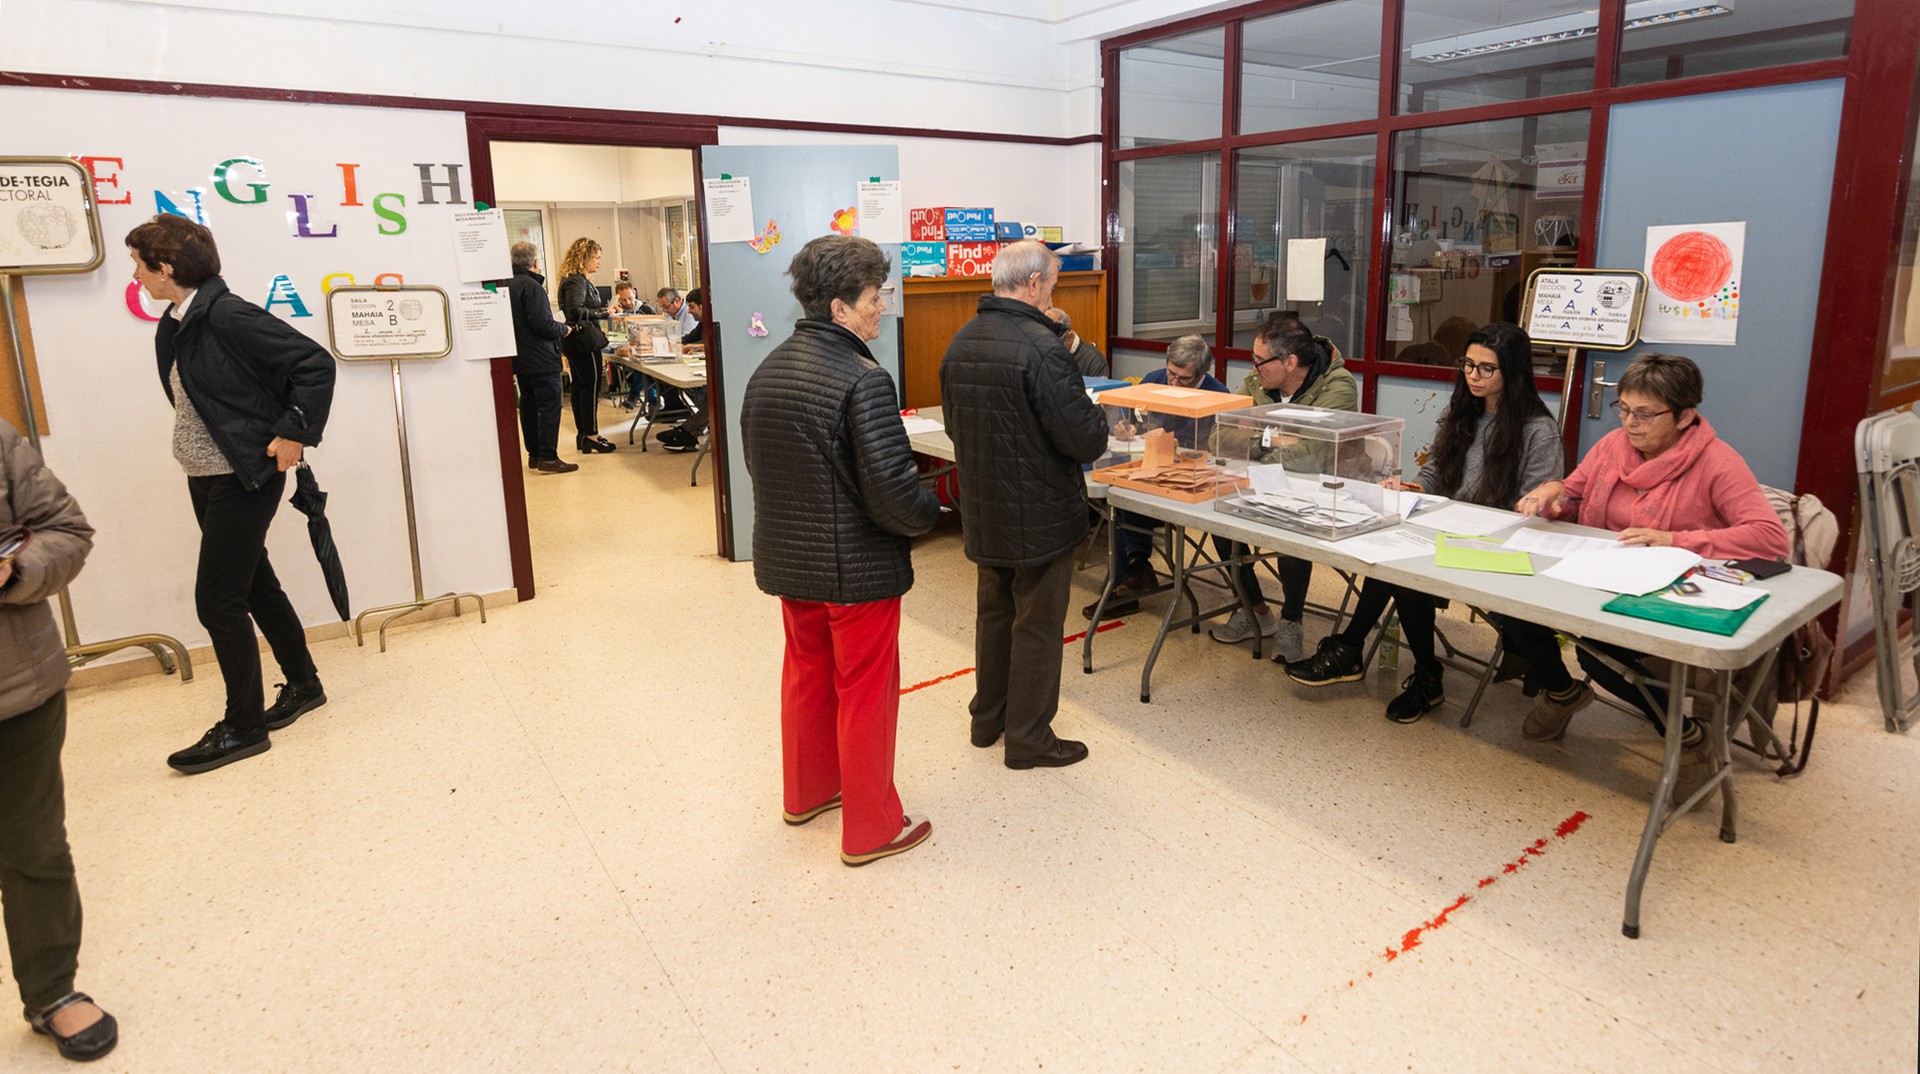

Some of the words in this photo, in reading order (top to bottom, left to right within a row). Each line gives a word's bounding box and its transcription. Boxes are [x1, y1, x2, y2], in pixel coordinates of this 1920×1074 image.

[68, 155, 468, 239] ENGLISH
[912, 208, 934, 225] Out!
[966, 212, 982, 220] Find
[921, 225, 944, 240] Find
[916, 246, 933, 254] Find
[948, 243, 982, 260] Find
[1574, 279, 1584, 293] 2
[387, 300, 394, 310] 2
[1541, 304, 1552, 313] A
[1590, 306, 1598, 316] K
[1565, 299, 1575, 310] A
[389, 314, 397, 326] B
[1561, 321, 1571, 330] A
[1597, 323, 1605, 332] K
